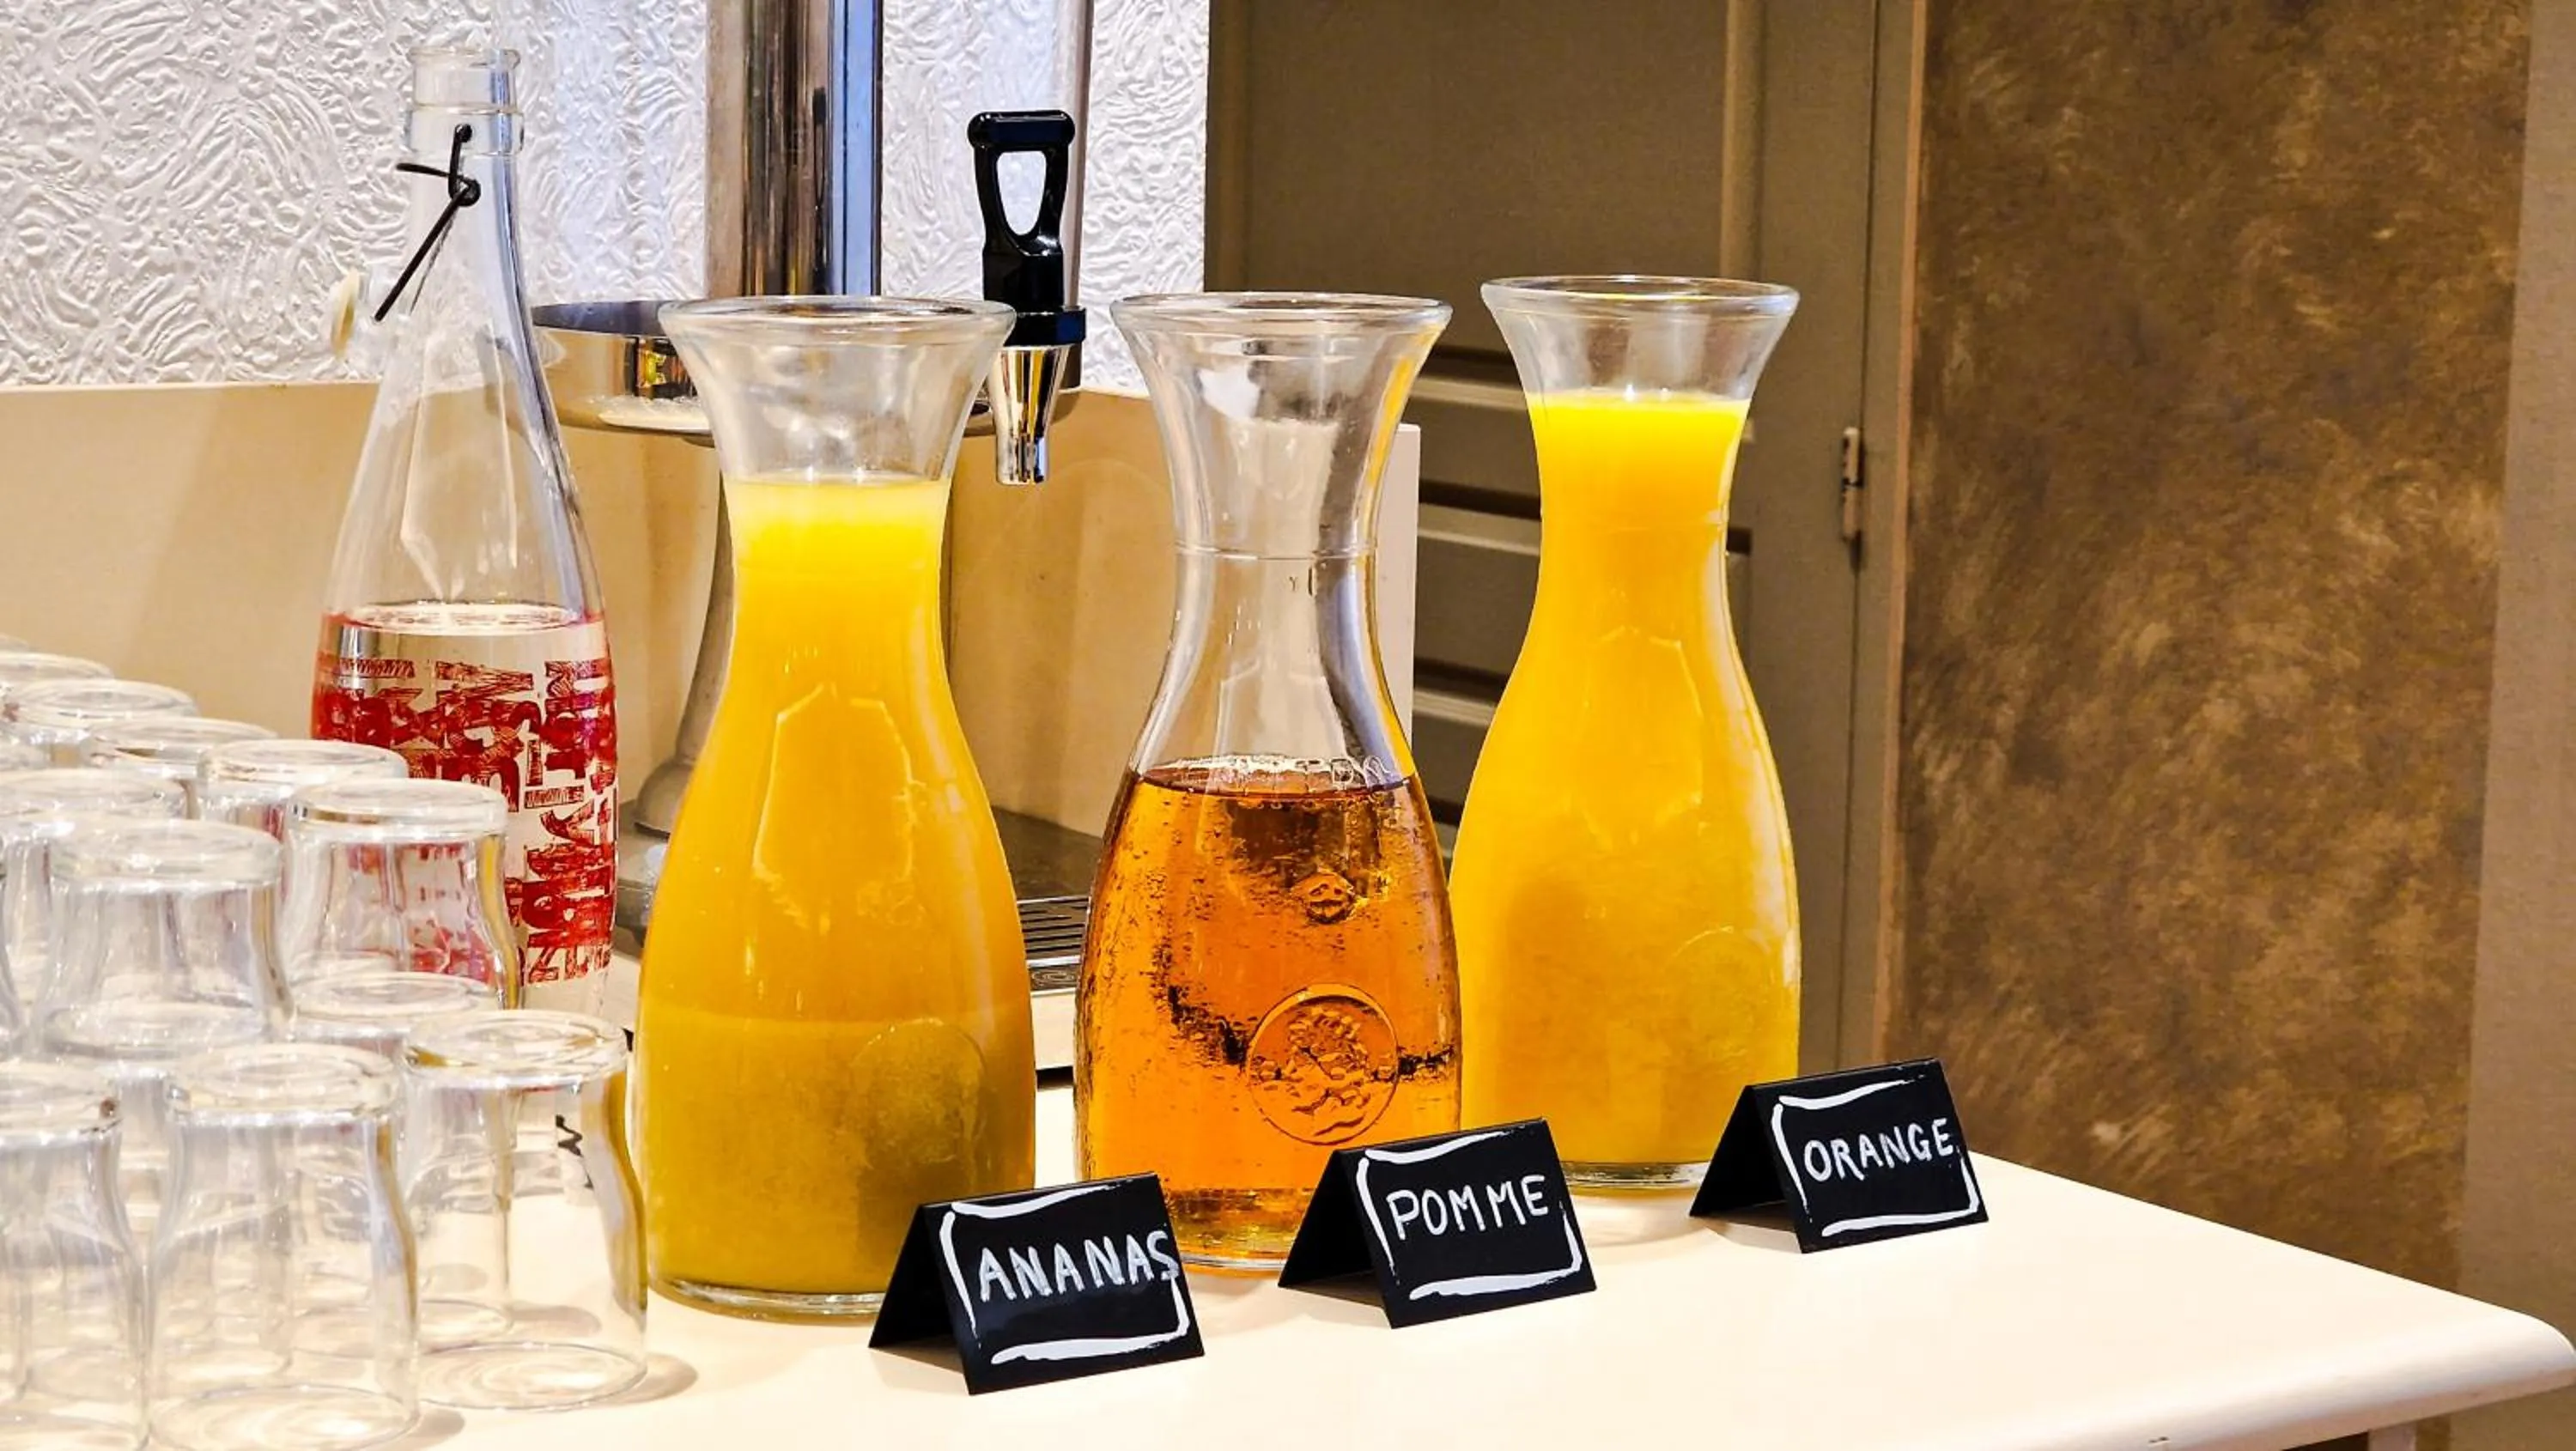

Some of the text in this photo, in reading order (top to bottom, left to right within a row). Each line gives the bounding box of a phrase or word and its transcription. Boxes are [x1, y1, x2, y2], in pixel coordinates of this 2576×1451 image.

[1803, 1118, 1954, 1181] ORANGE
[1385, 1174, 1549, 1241] POMME
[978, 1229, 1179, 1302] ANANAS
